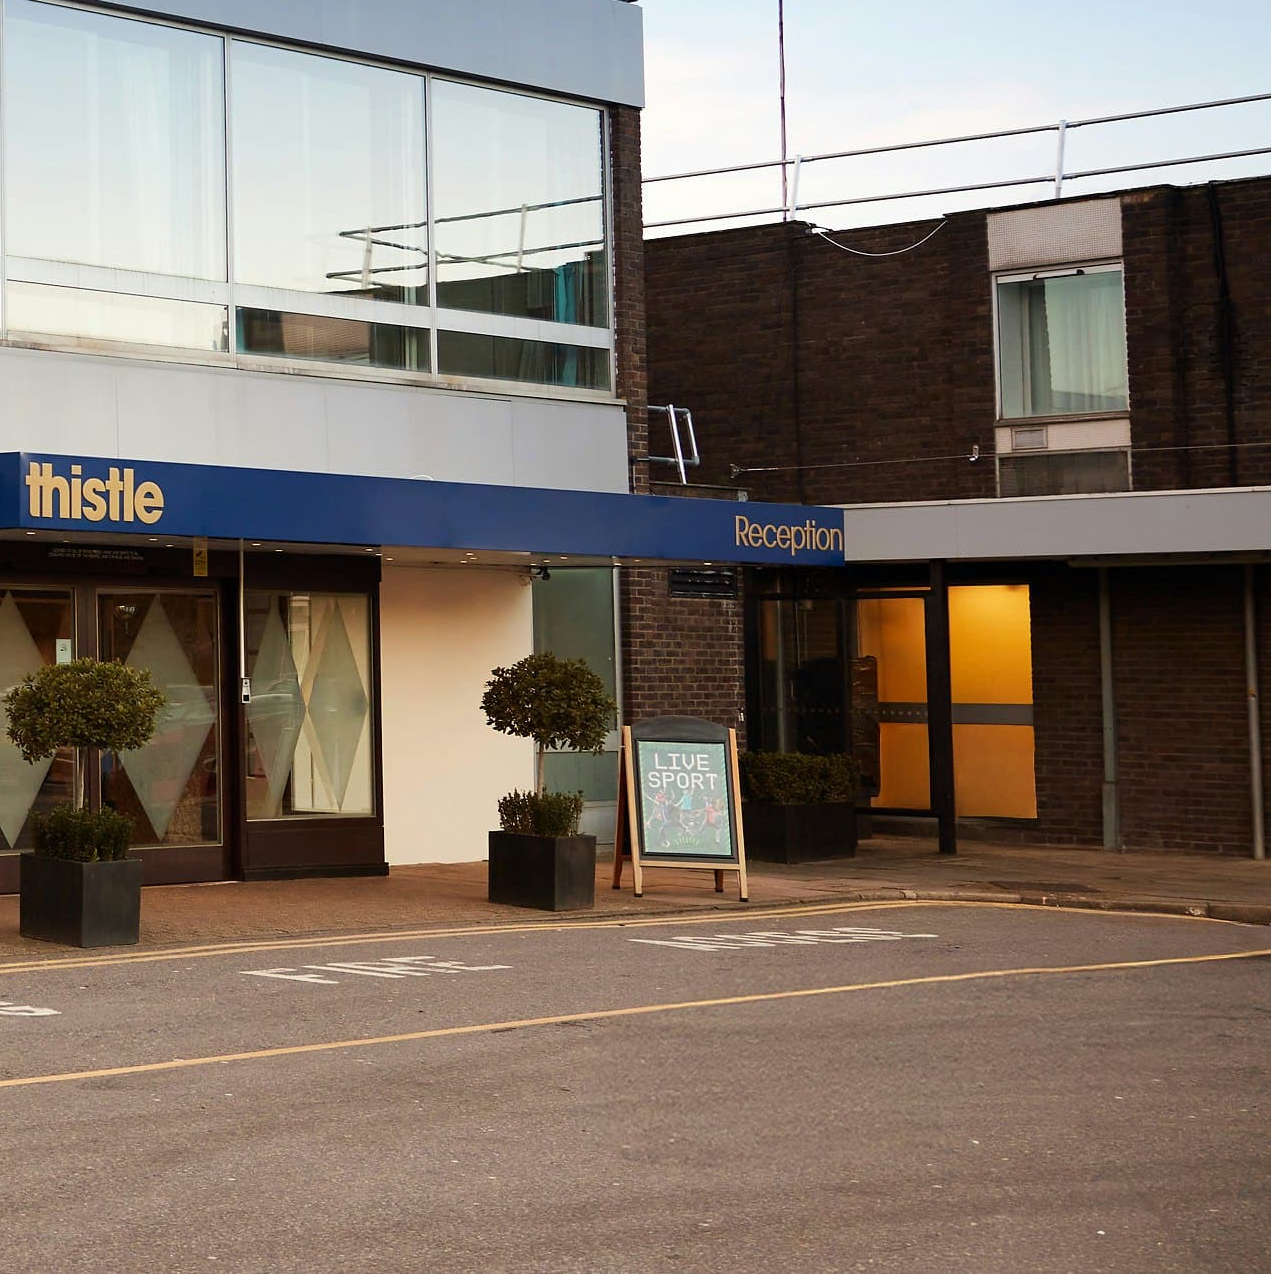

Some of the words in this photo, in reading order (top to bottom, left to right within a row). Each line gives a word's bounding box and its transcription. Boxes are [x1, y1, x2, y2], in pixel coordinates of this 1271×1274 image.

[25, 461, 165, 524] thistle
[735, 515, 843, 556] Reception
[654, 753, 711, 771] LIVE
[648, 772, 718, 791] SPORT
[239, 955, 513, 984] FIRE
